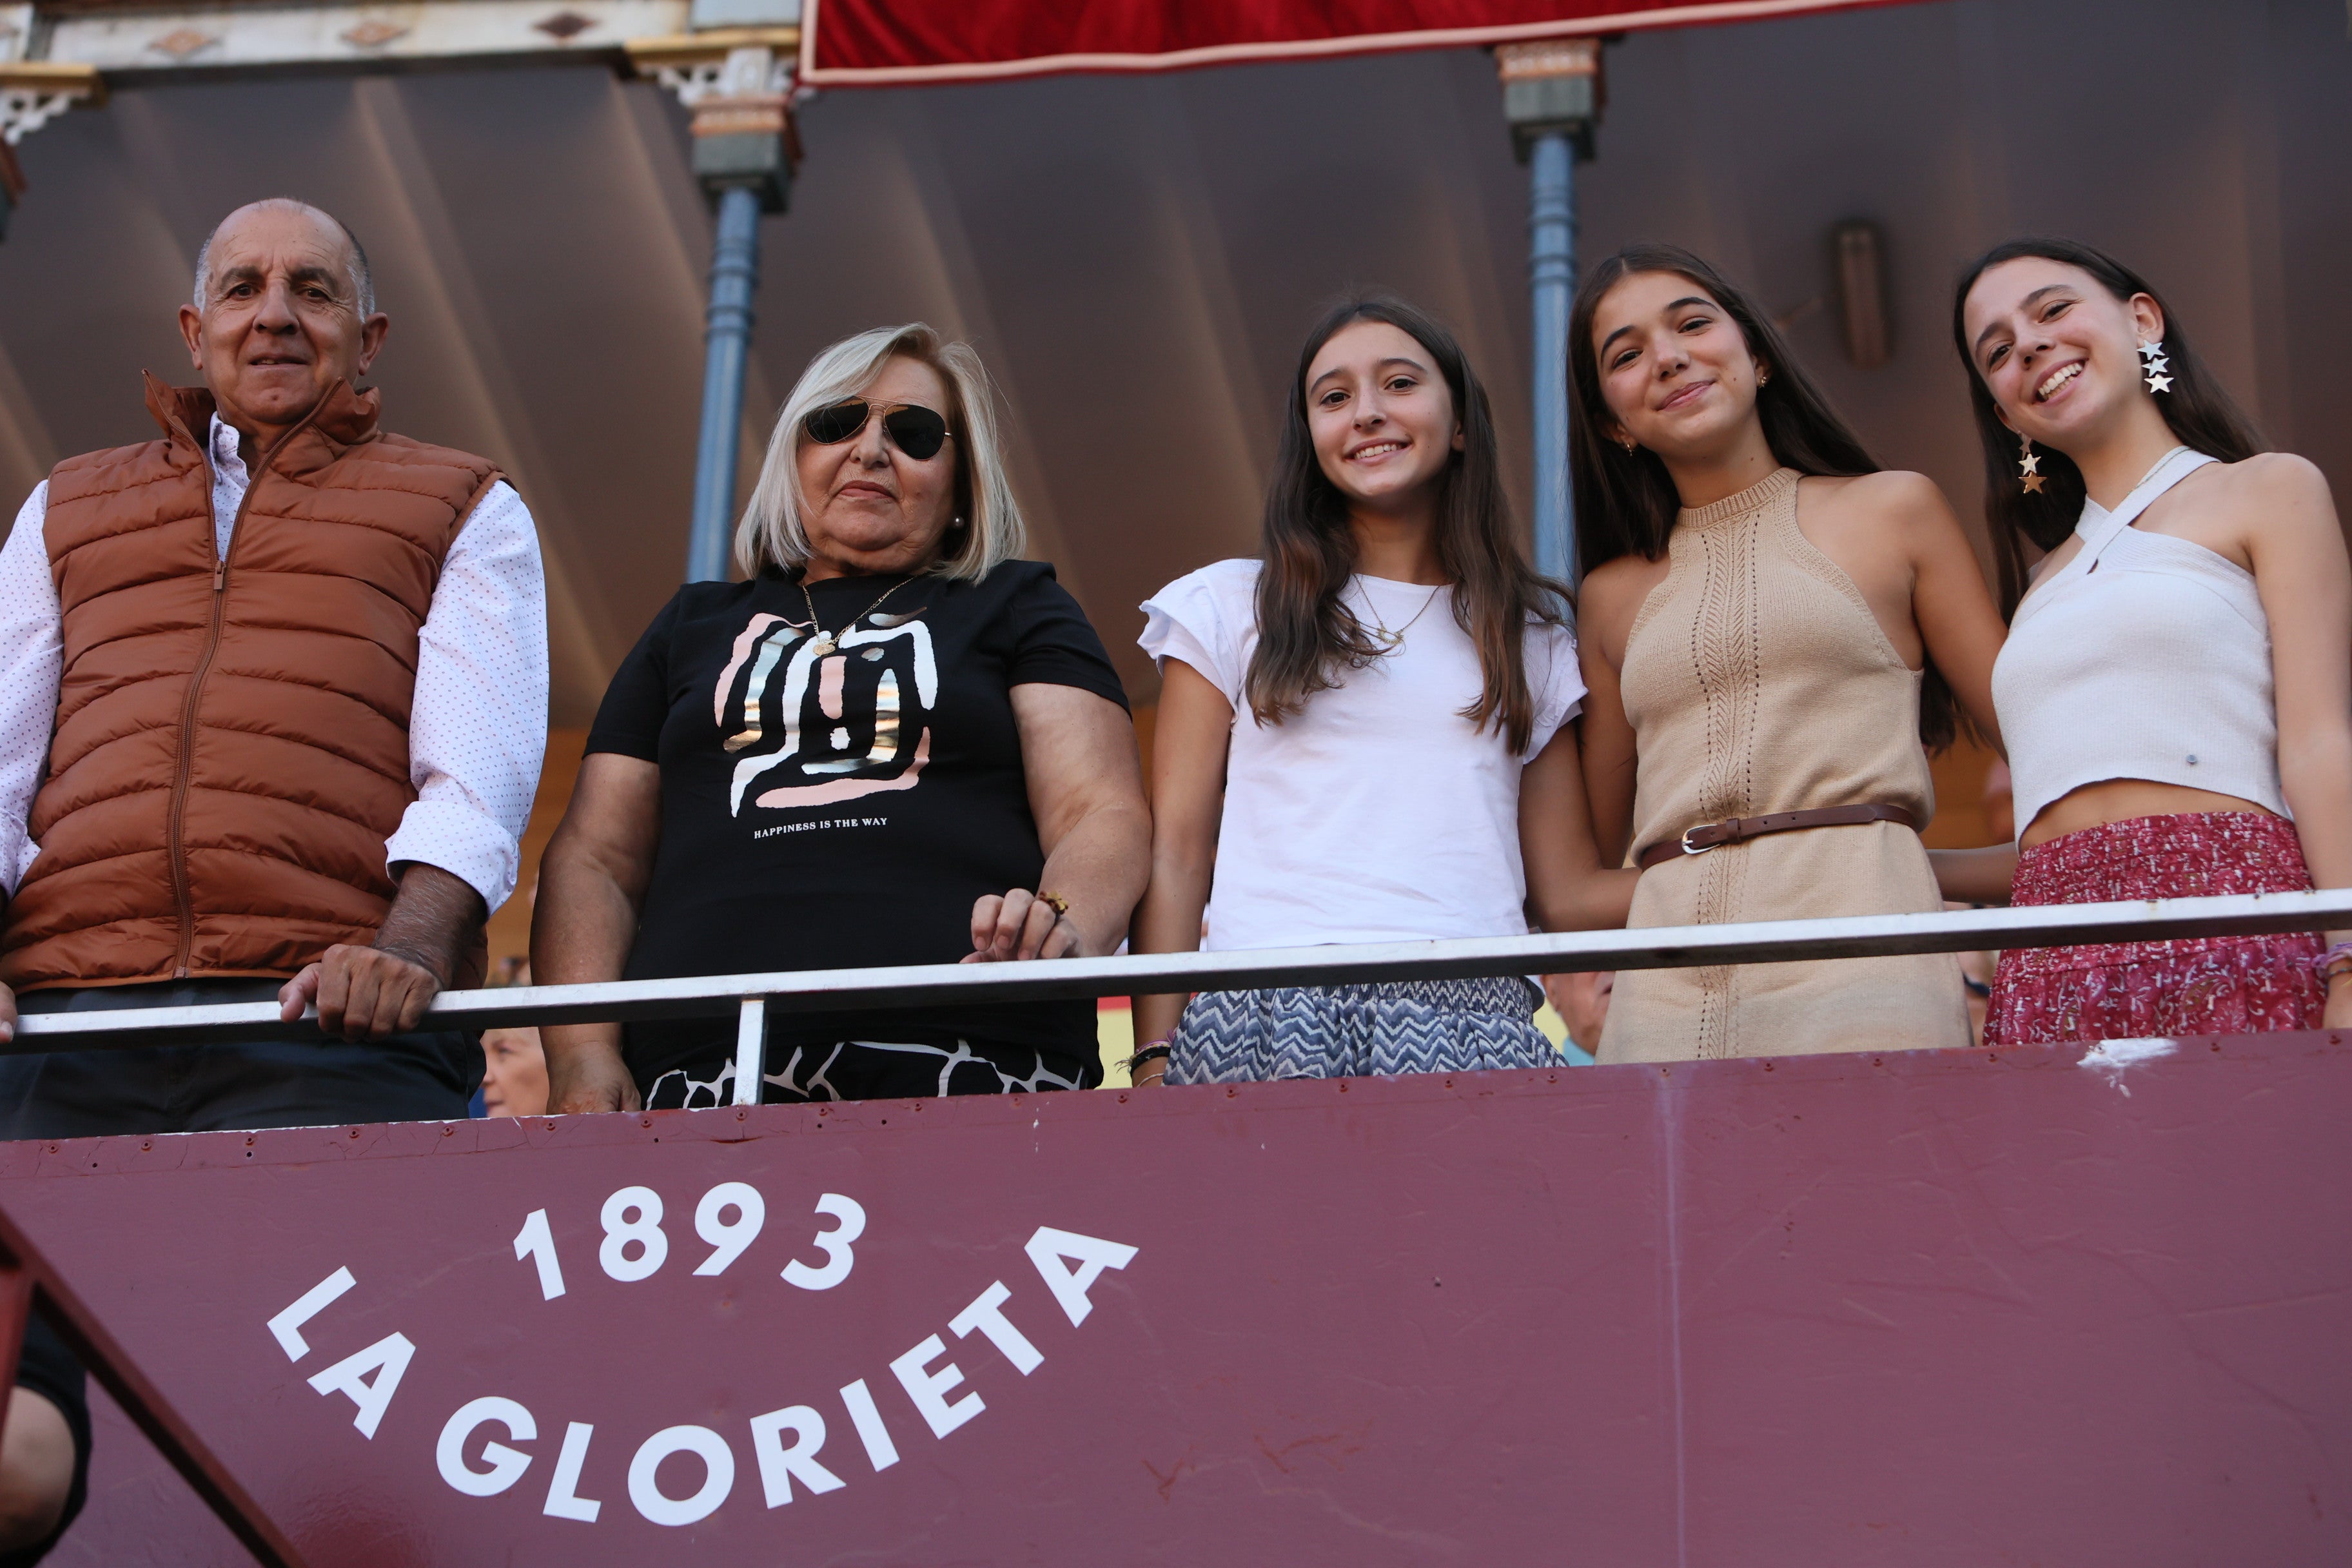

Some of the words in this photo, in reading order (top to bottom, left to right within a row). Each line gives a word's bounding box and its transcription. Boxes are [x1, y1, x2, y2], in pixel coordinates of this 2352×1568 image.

[754, 821, 817, 839] HAPPINESS
[819, 820, 831, 829] IS
[834, 818, 859, 828] THE
[861, 818, 888, 826] WAY
[513, 1182, 866, 1300] 1893
[266, 1265, 416, 1440] LA
[436, 1226, 1139, 1526] GLORIETA
